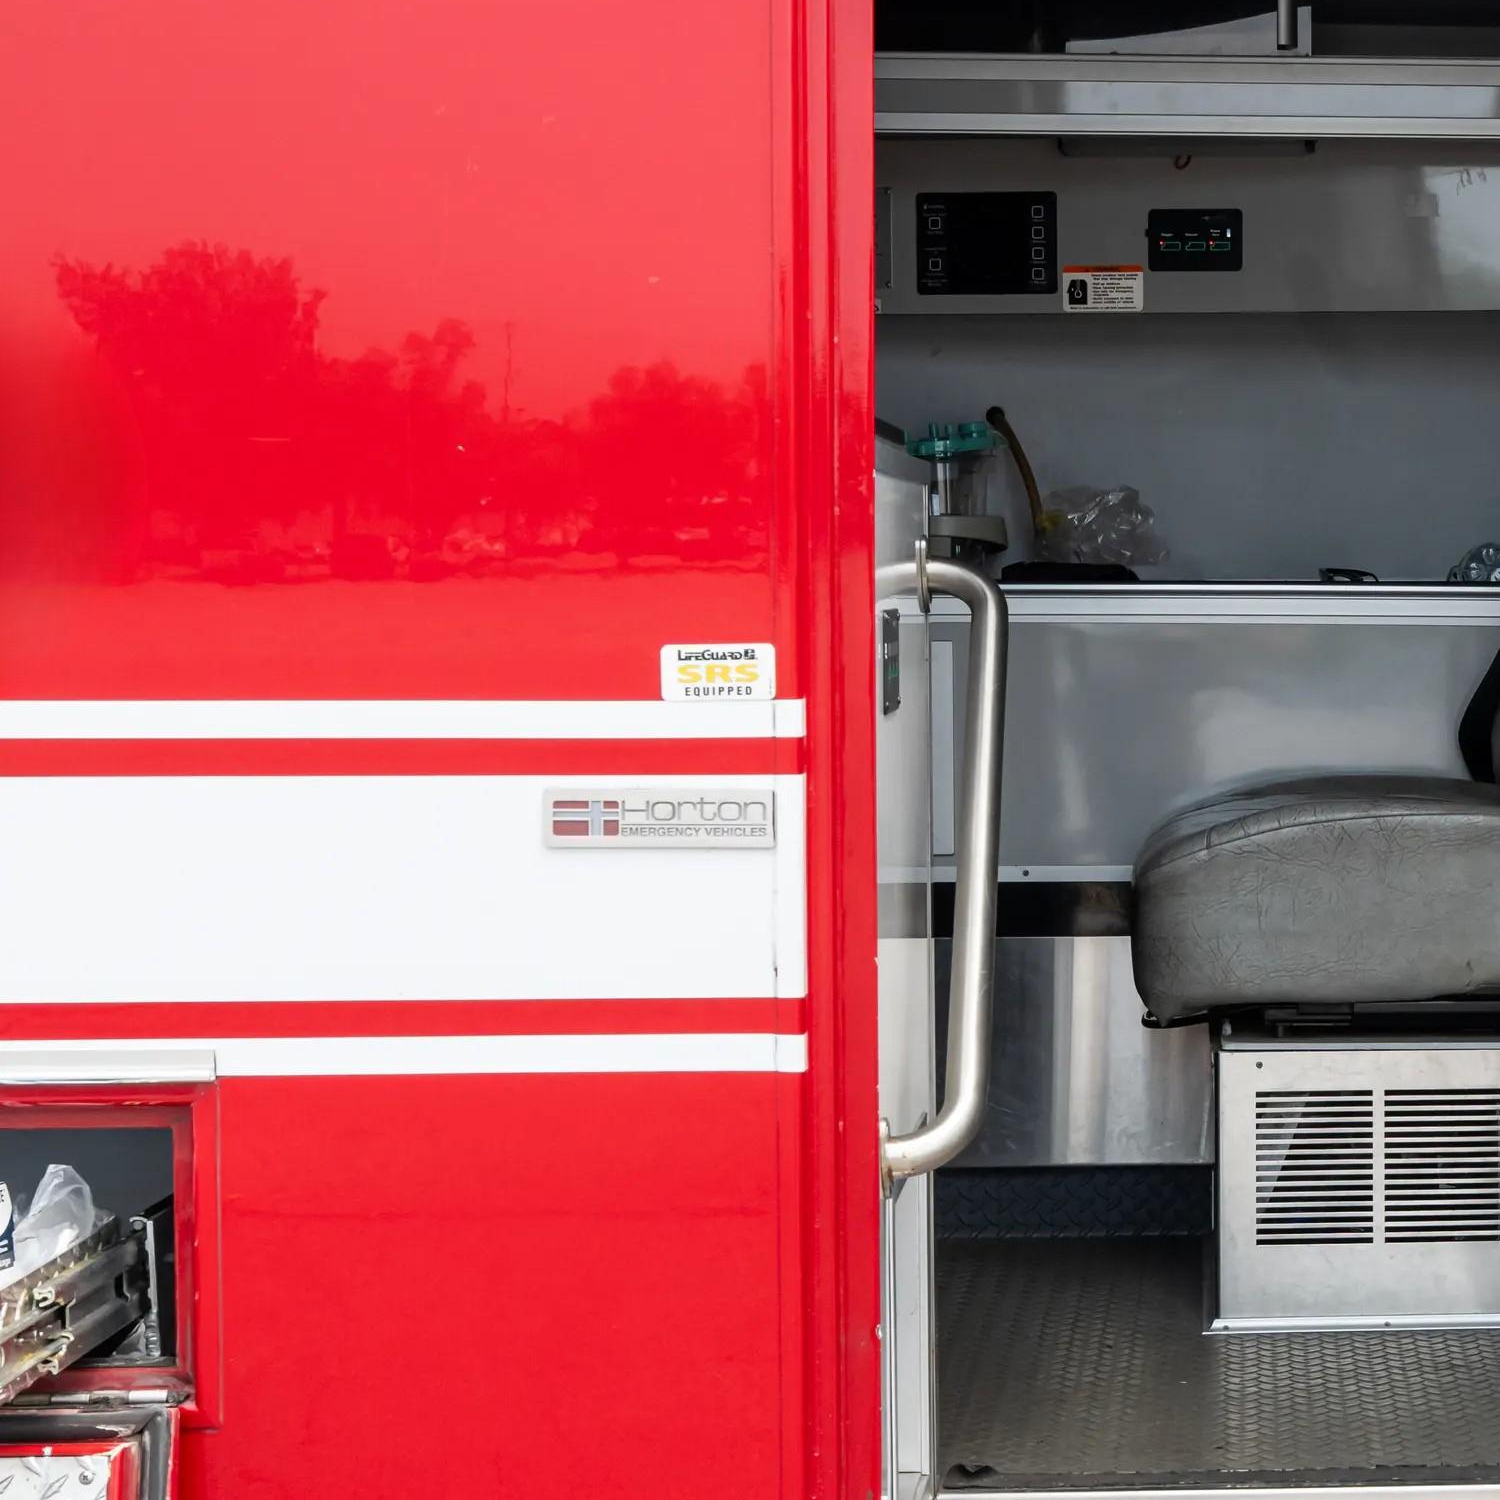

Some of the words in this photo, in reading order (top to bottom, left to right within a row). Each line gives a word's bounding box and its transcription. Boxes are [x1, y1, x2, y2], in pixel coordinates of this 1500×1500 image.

[677, 663, 760, 684] SRS
[685, 686, 753, 697] EQUIPPED
[621, 797, 767, 821] Horton
[621, 827, 701, 837] EMERGENCY
[704, 827, 767, 837] VEHICLES
